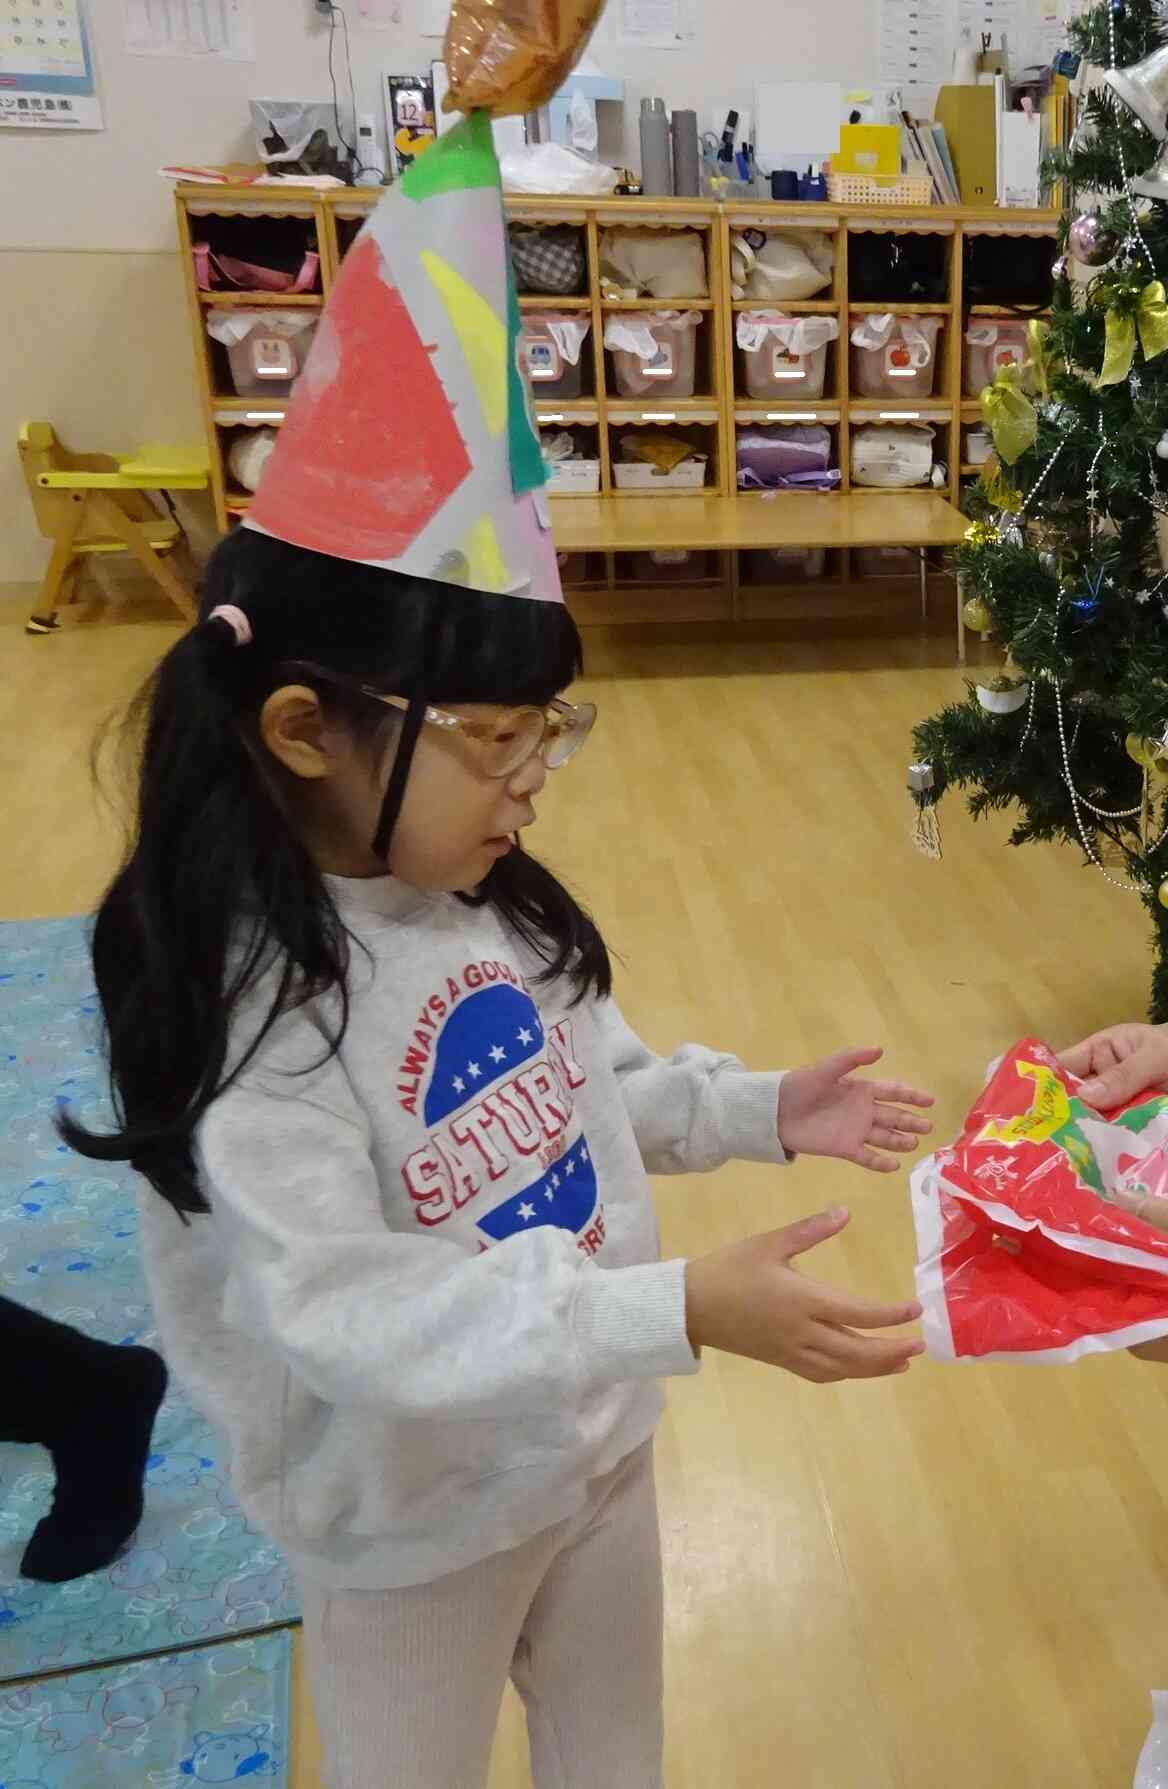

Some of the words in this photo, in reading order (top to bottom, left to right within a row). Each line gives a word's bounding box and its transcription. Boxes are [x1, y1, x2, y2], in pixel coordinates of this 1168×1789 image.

[401, 103, 417, 120] 12
[397, 994, 447, 1116] ALWAYS
[446, 976, 461, 1003] A
